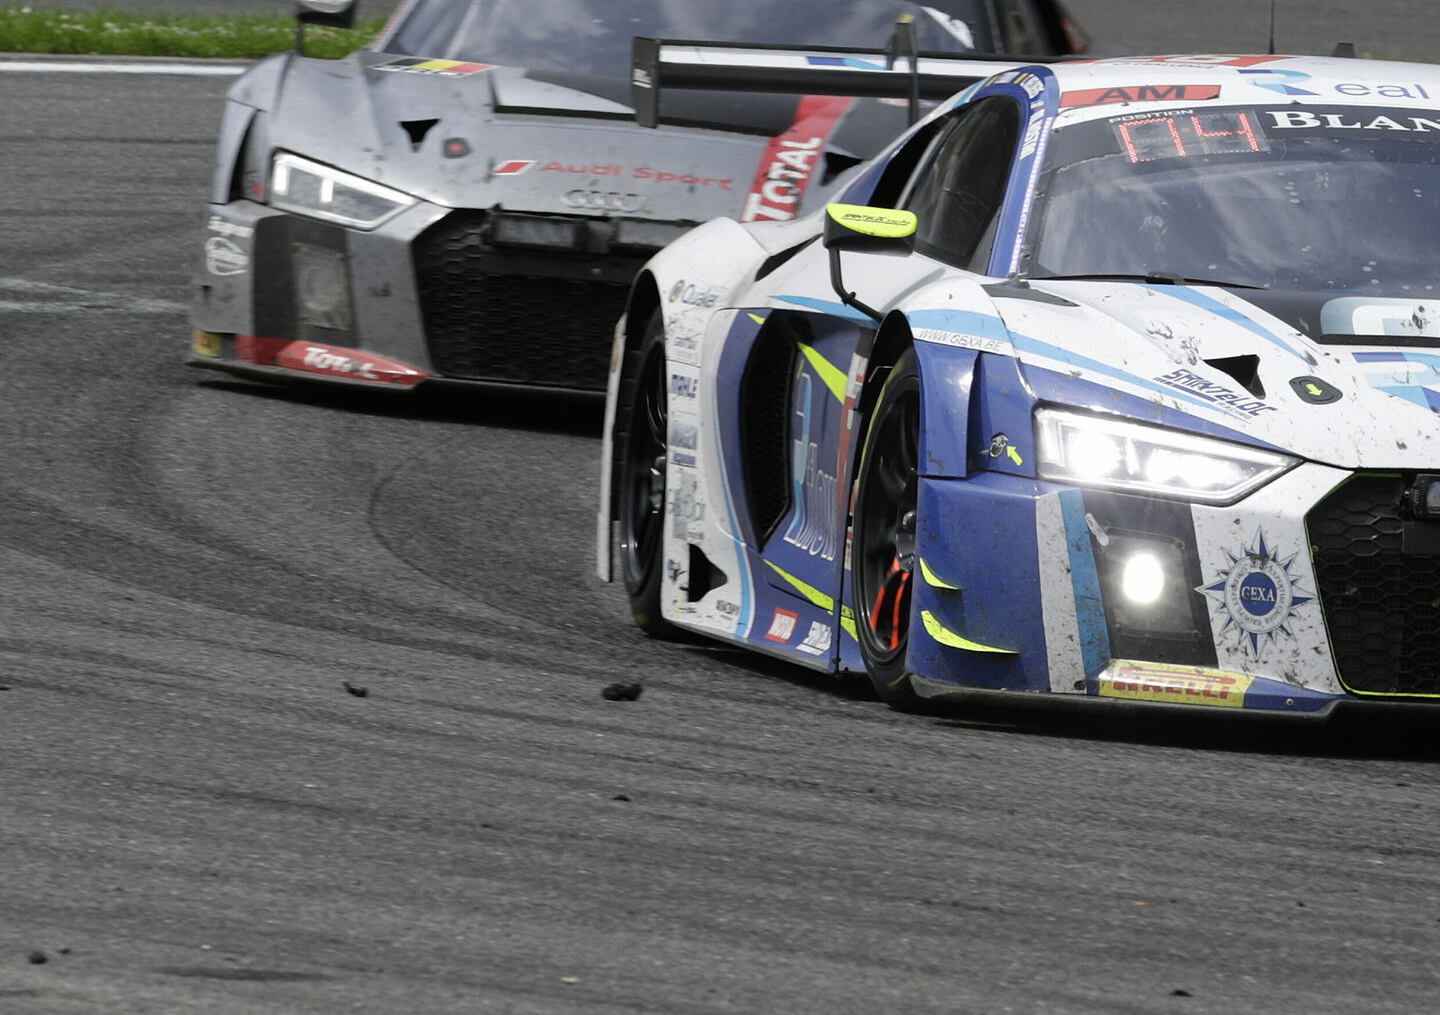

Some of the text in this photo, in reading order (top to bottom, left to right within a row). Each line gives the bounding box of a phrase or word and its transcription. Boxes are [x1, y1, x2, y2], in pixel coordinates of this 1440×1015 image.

[1095, 85, 1187, 103] AM
[1108, 108, 1194, 124] POSITION
[539, 160, 734, 192] Audi Sport
[740, 136, 825, 224] TOTAL
[1241, 585, 1276, 604] GEXA
